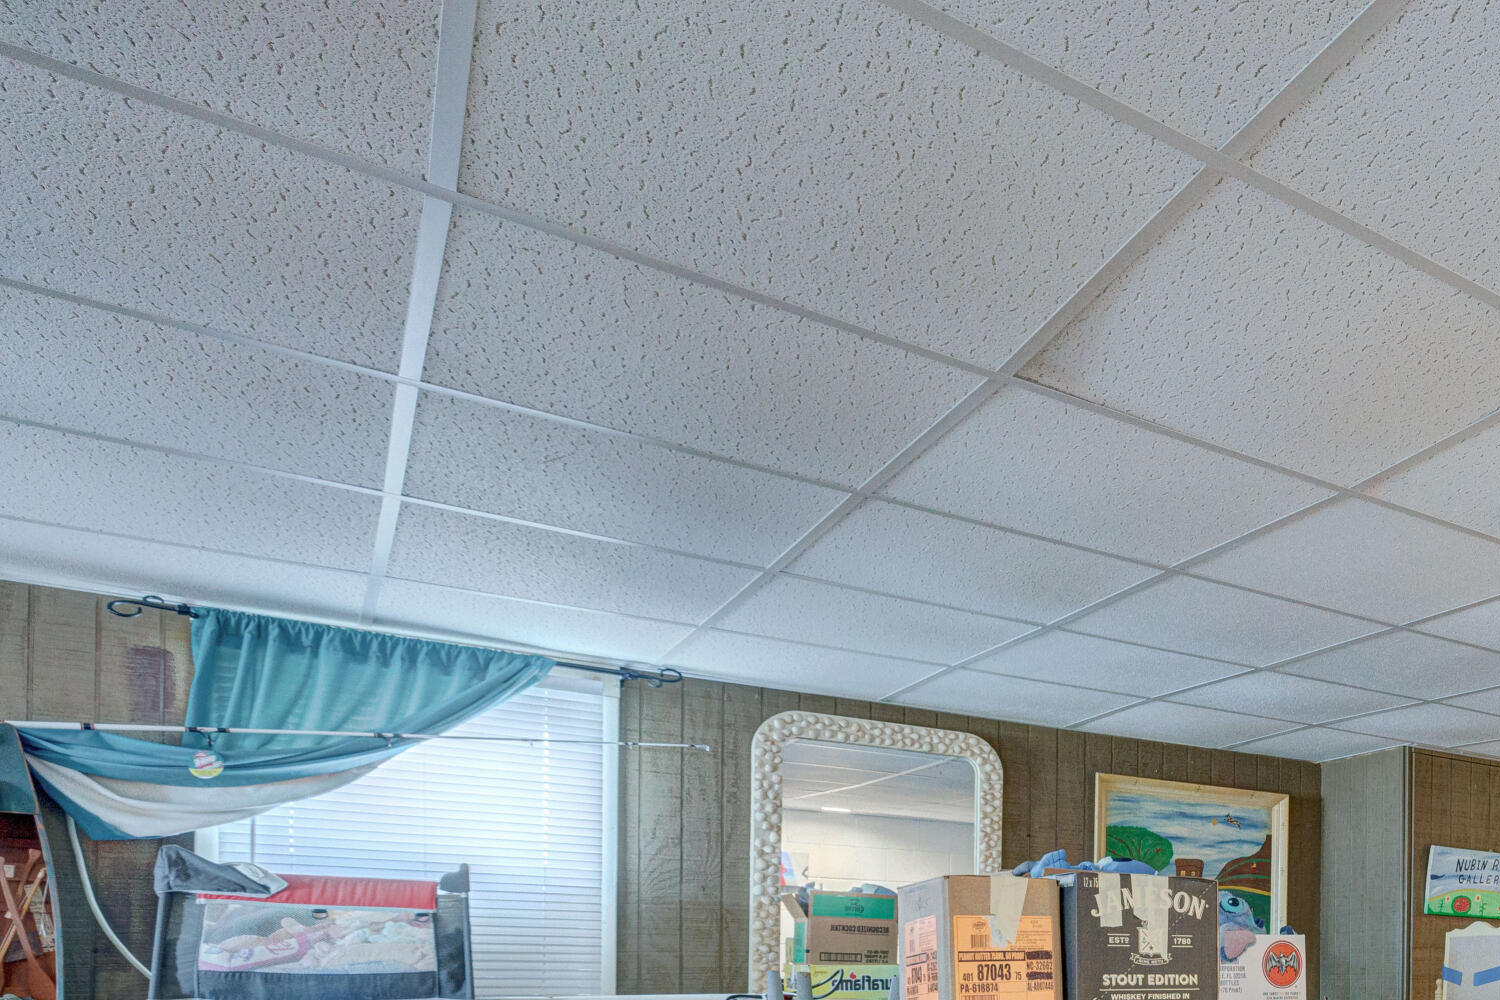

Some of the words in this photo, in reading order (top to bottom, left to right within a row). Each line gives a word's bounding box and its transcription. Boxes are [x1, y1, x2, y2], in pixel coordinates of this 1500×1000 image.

[977, 963, 1011, 982] 87043
[1102, 974, 1145, 986] STOUT
[1147, 974, 1198, 986] EDITION
[1182, 992, 1190, 1000] IN
